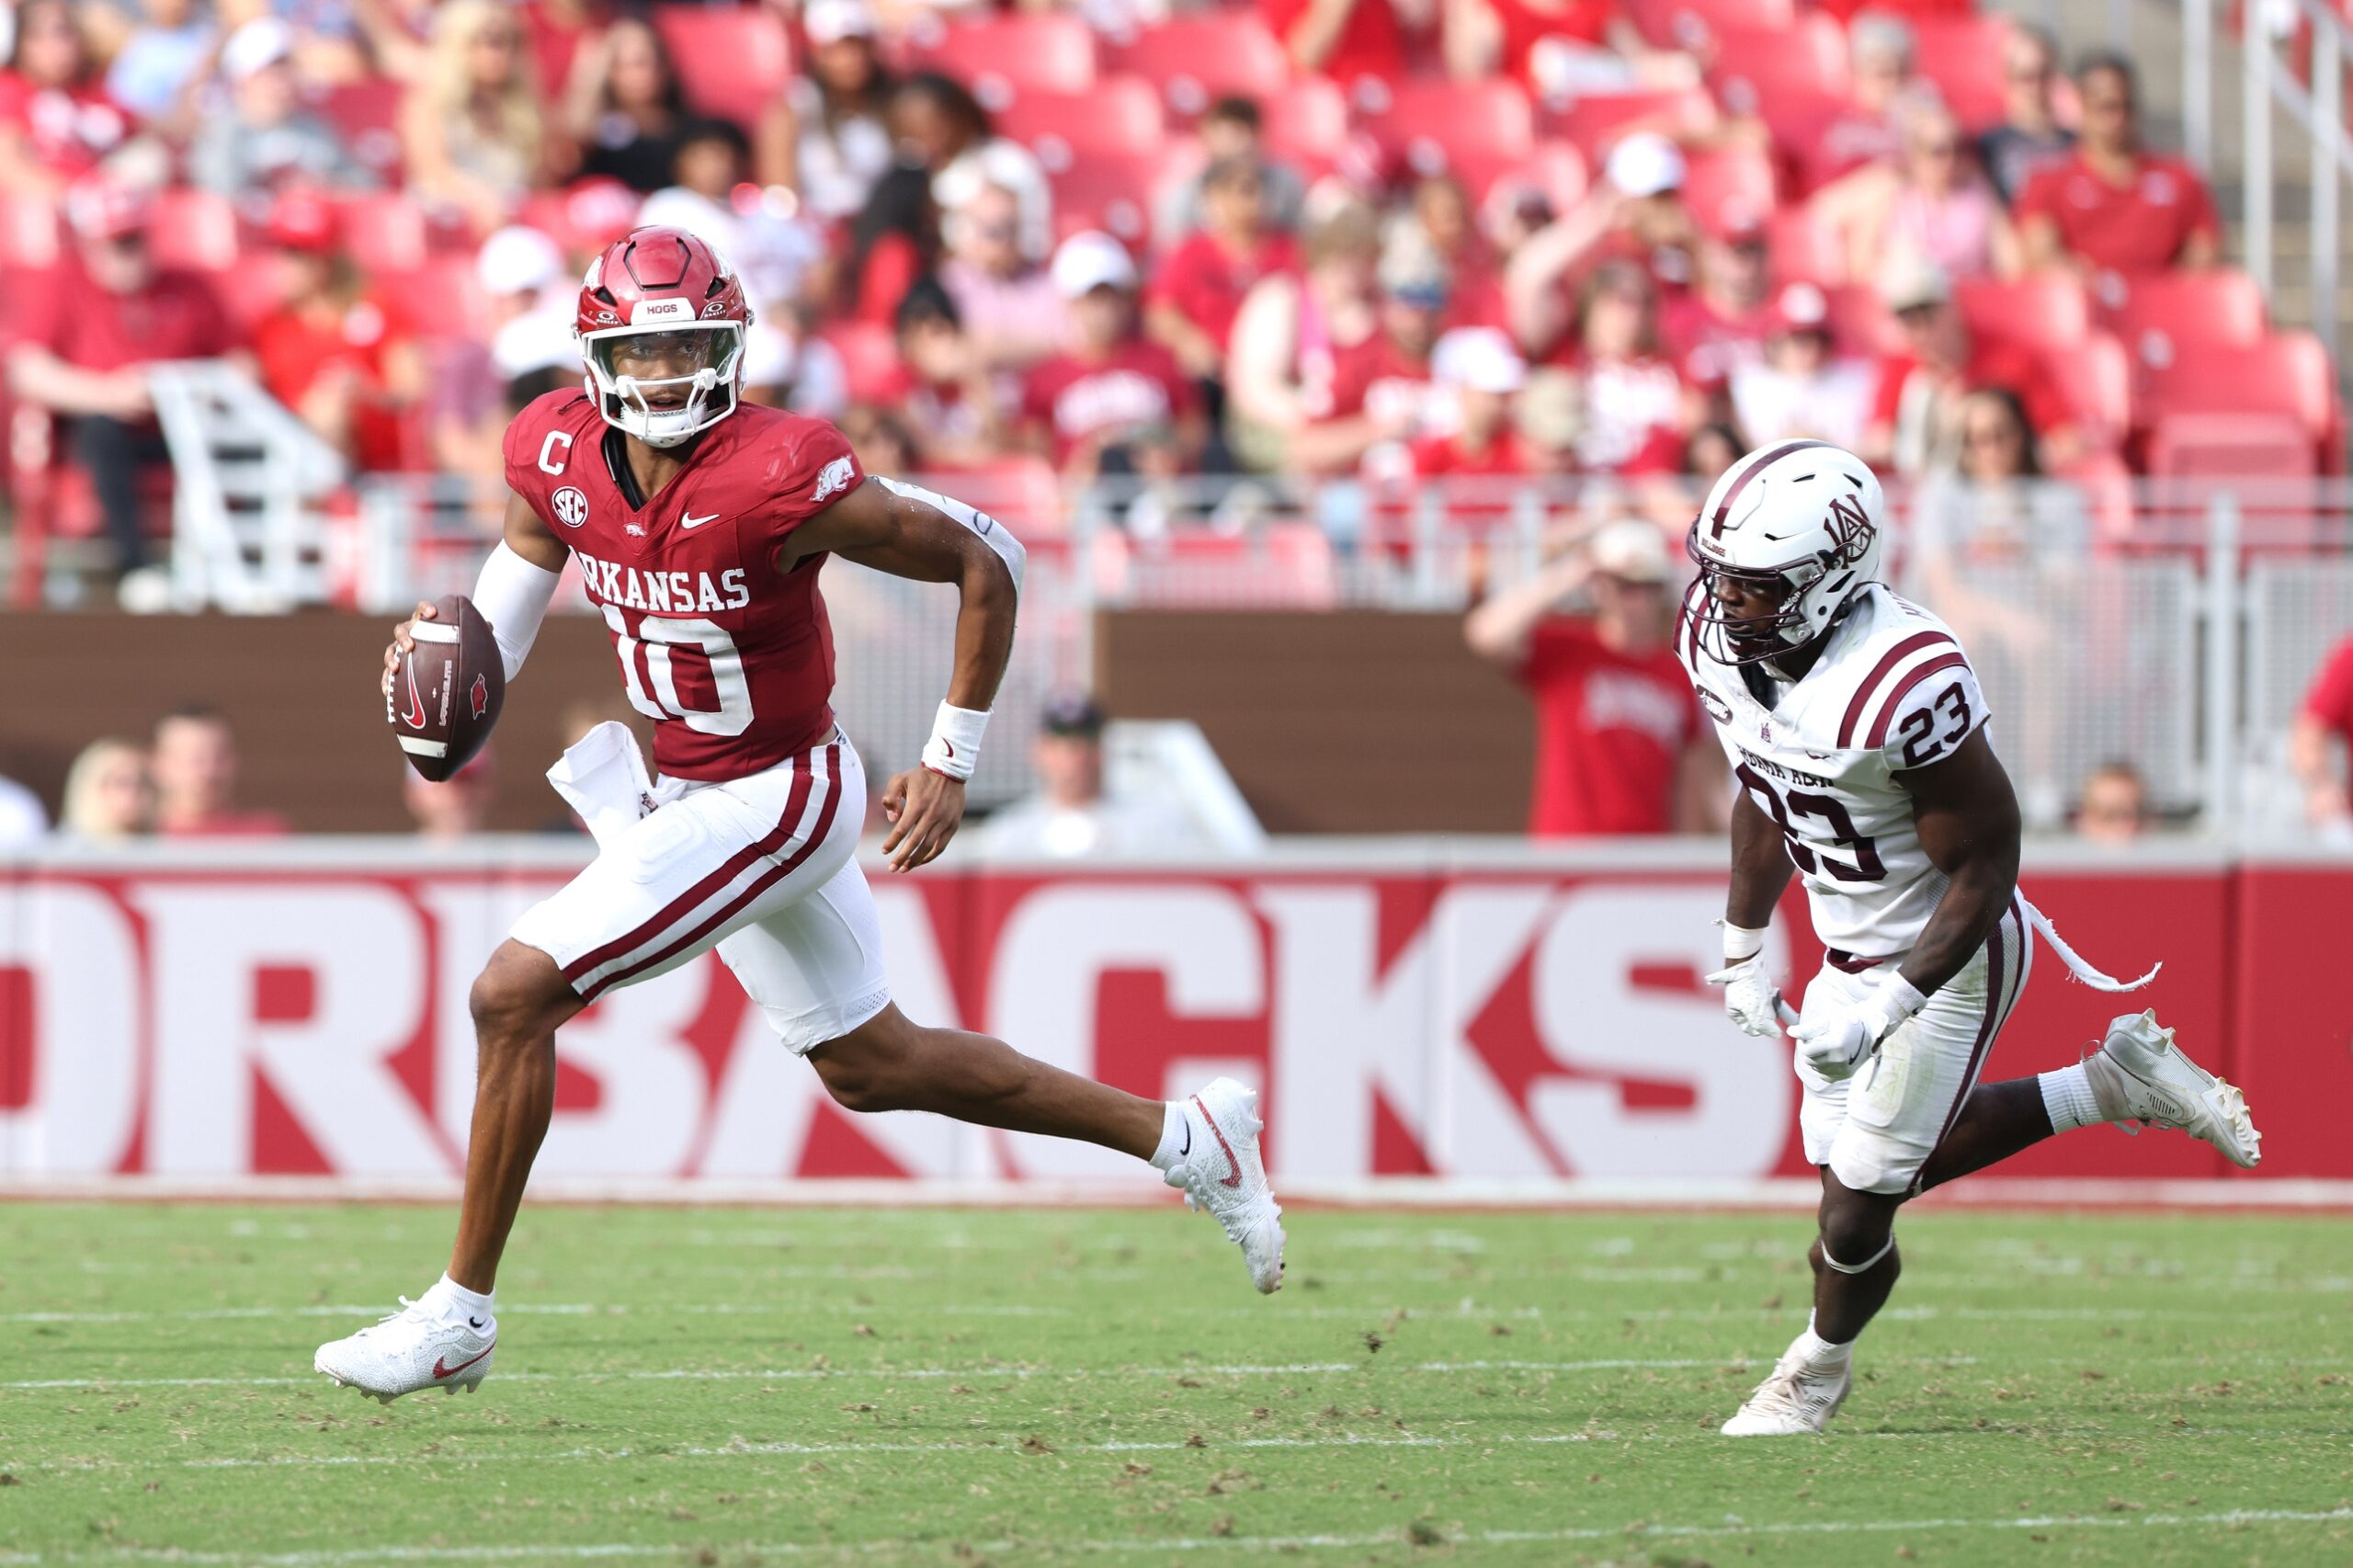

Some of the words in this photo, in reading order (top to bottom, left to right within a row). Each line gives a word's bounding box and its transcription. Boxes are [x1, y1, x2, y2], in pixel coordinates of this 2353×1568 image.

[646, 304, 677, 314] HOGS
[538, 429, 573, 476] C
[554, 489, 585, 525] SEC
[568, 544, 750, 613] RKANSAS
[600, 602, 755, 736] 10
[1899, 681, 1971, 767] 23
